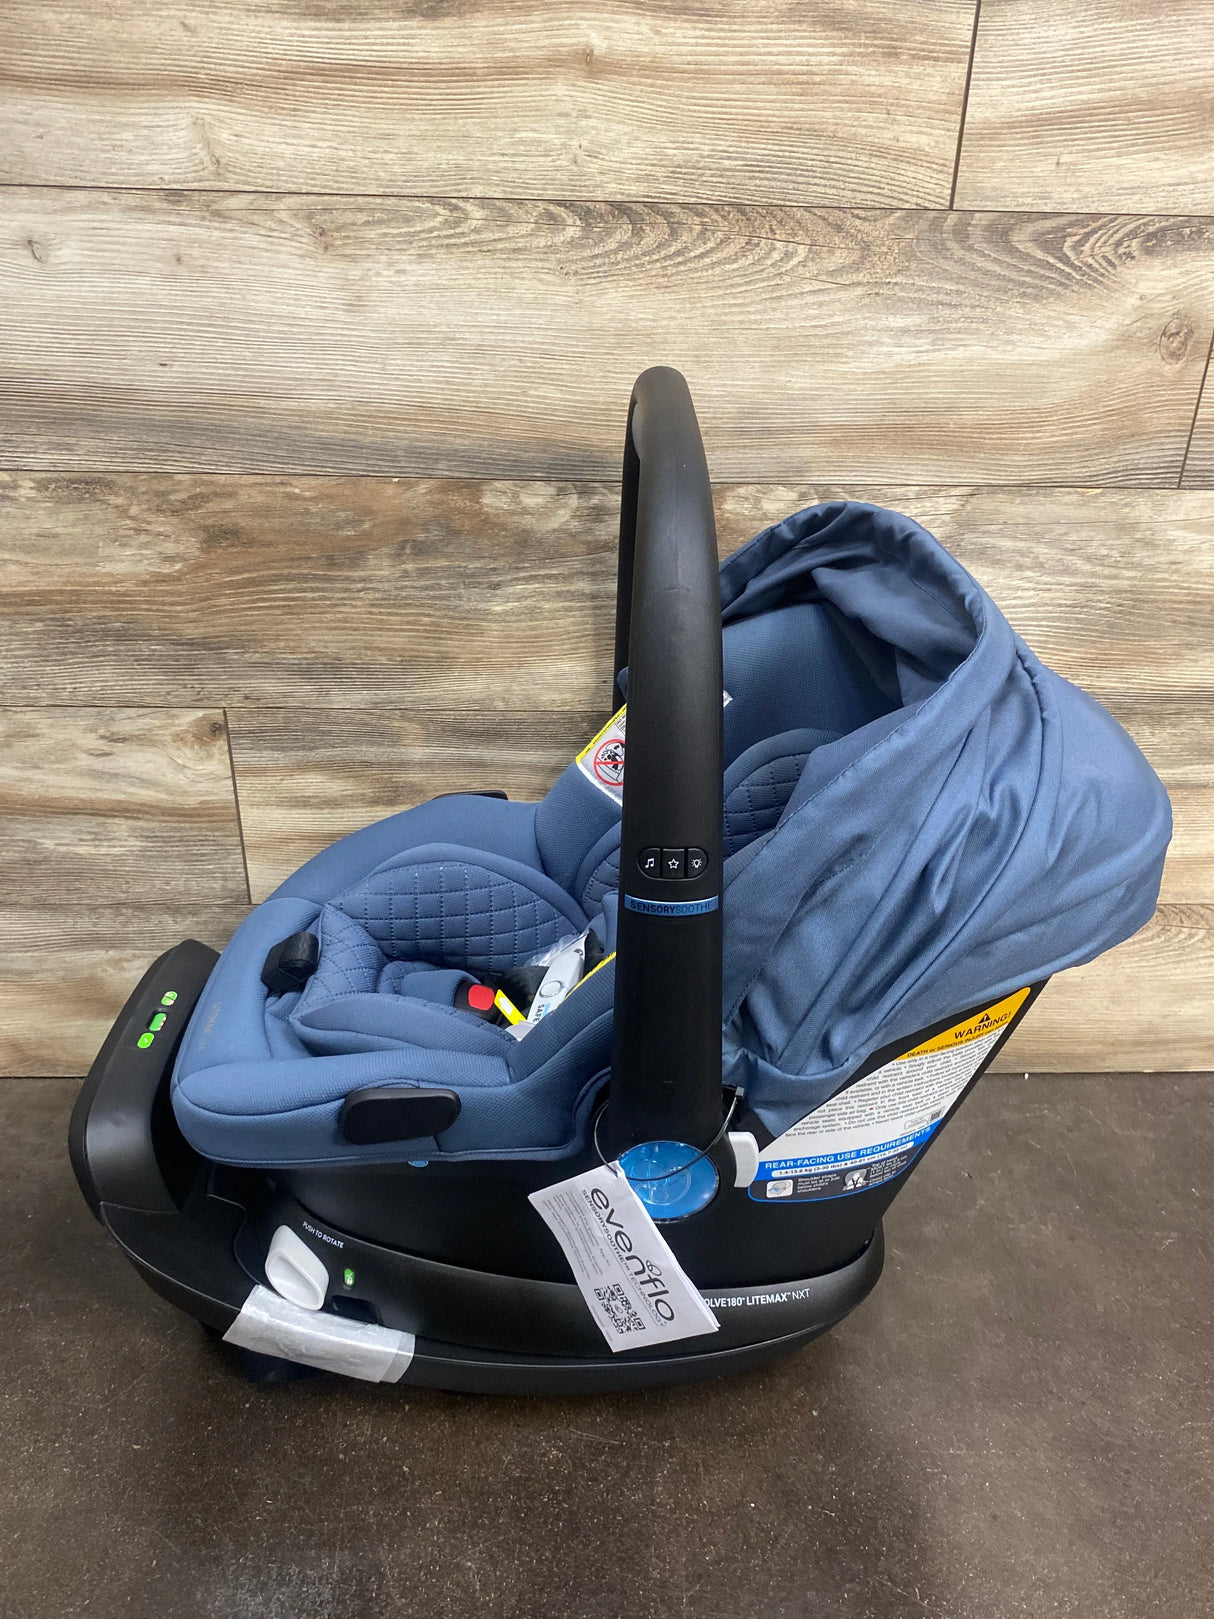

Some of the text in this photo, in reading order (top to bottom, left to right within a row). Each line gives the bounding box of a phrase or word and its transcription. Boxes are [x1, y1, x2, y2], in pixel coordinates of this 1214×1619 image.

[630, 900, 712, 914] SENSORYSOOTHE
[533, 1004, 545, 1023] SAFE
[954, 1012, 1012, 1040] WARNING!
[907, 1049, 928, 1058] DEATH
[765, 1155, 835, 1170] REAR-FACING
[837, 1151, 858, 1161] USE
[860, 1126, 931, 1156] REQUIREMENTS
[302, 1221, 345, 1248] PUSH TO ROTATE
[591, 1188, 675, 1322] evenflo
[628, 1273, 666, 1327] TECHNOLOGY
[792, 1288, 811, 1300] NXT
